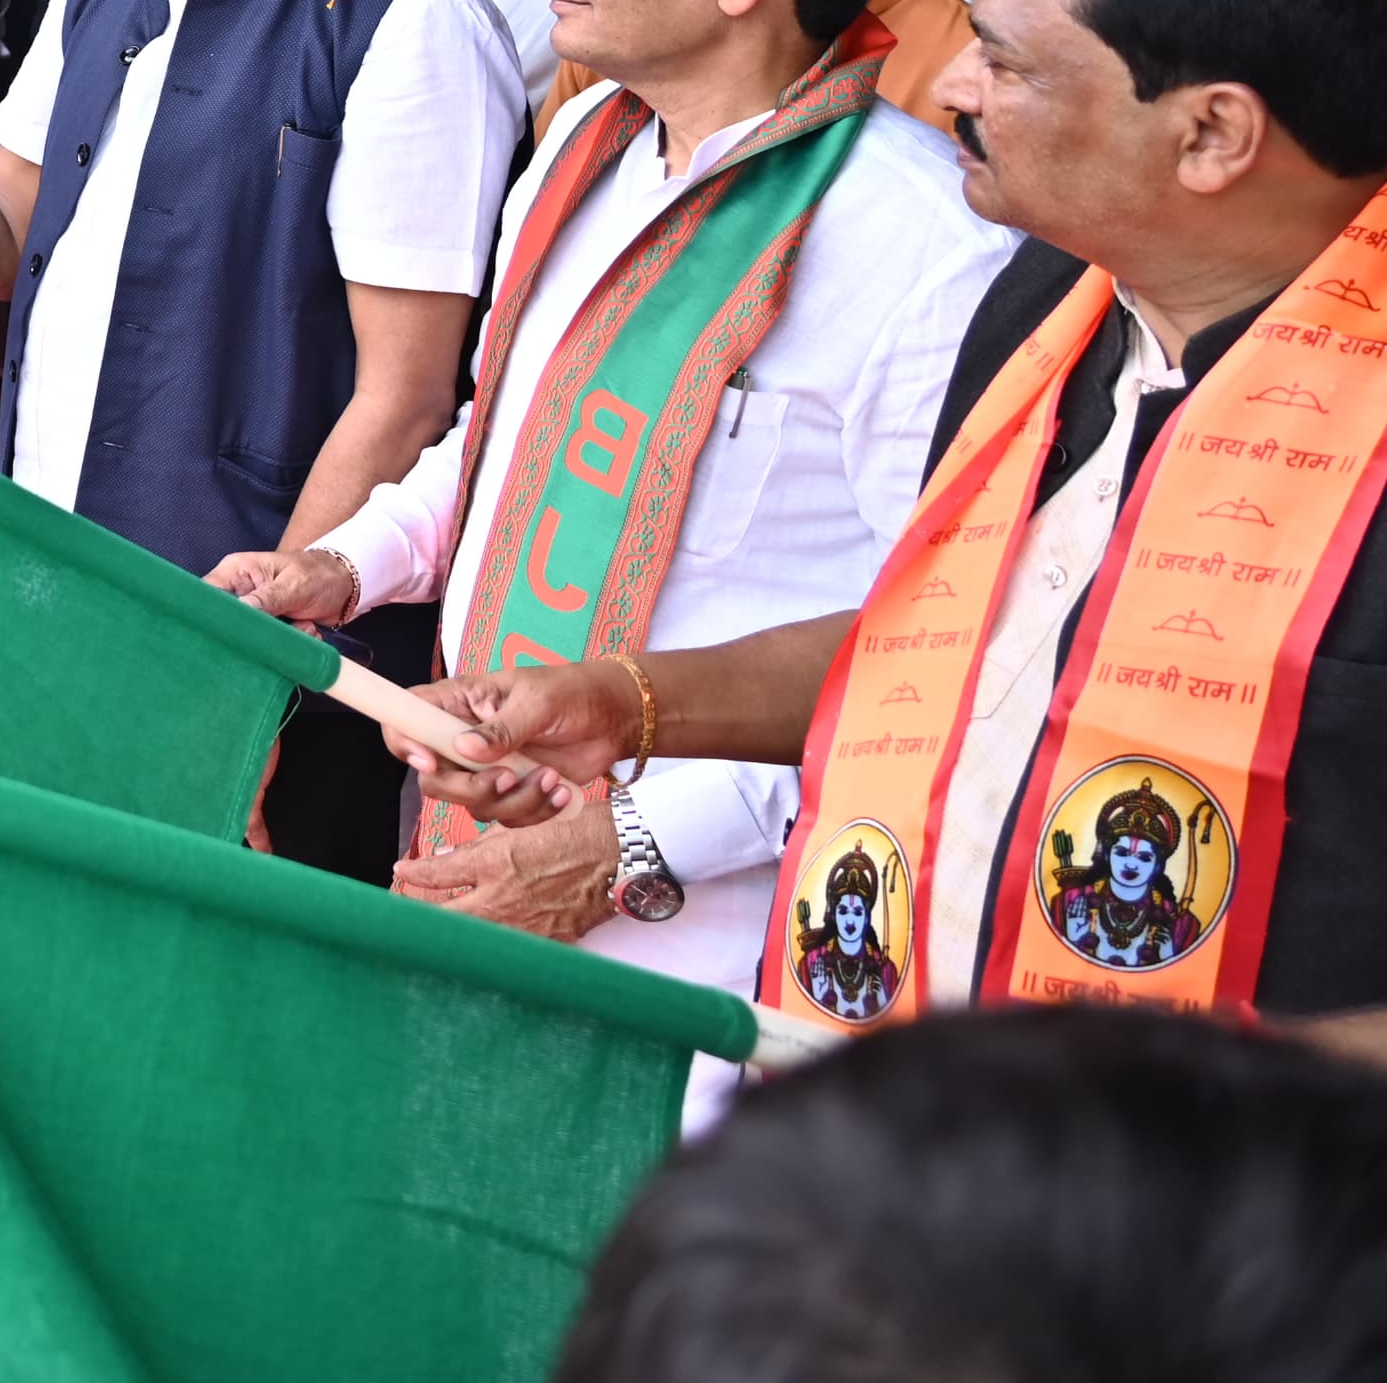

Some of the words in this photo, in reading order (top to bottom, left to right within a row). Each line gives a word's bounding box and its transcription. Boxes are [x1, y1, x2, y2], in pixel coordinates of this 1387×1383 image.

[1285, 448, 1337, 472] राम
[1231, 562, 1281, 585] राम
[1187, 676, 1235, 702] राम
